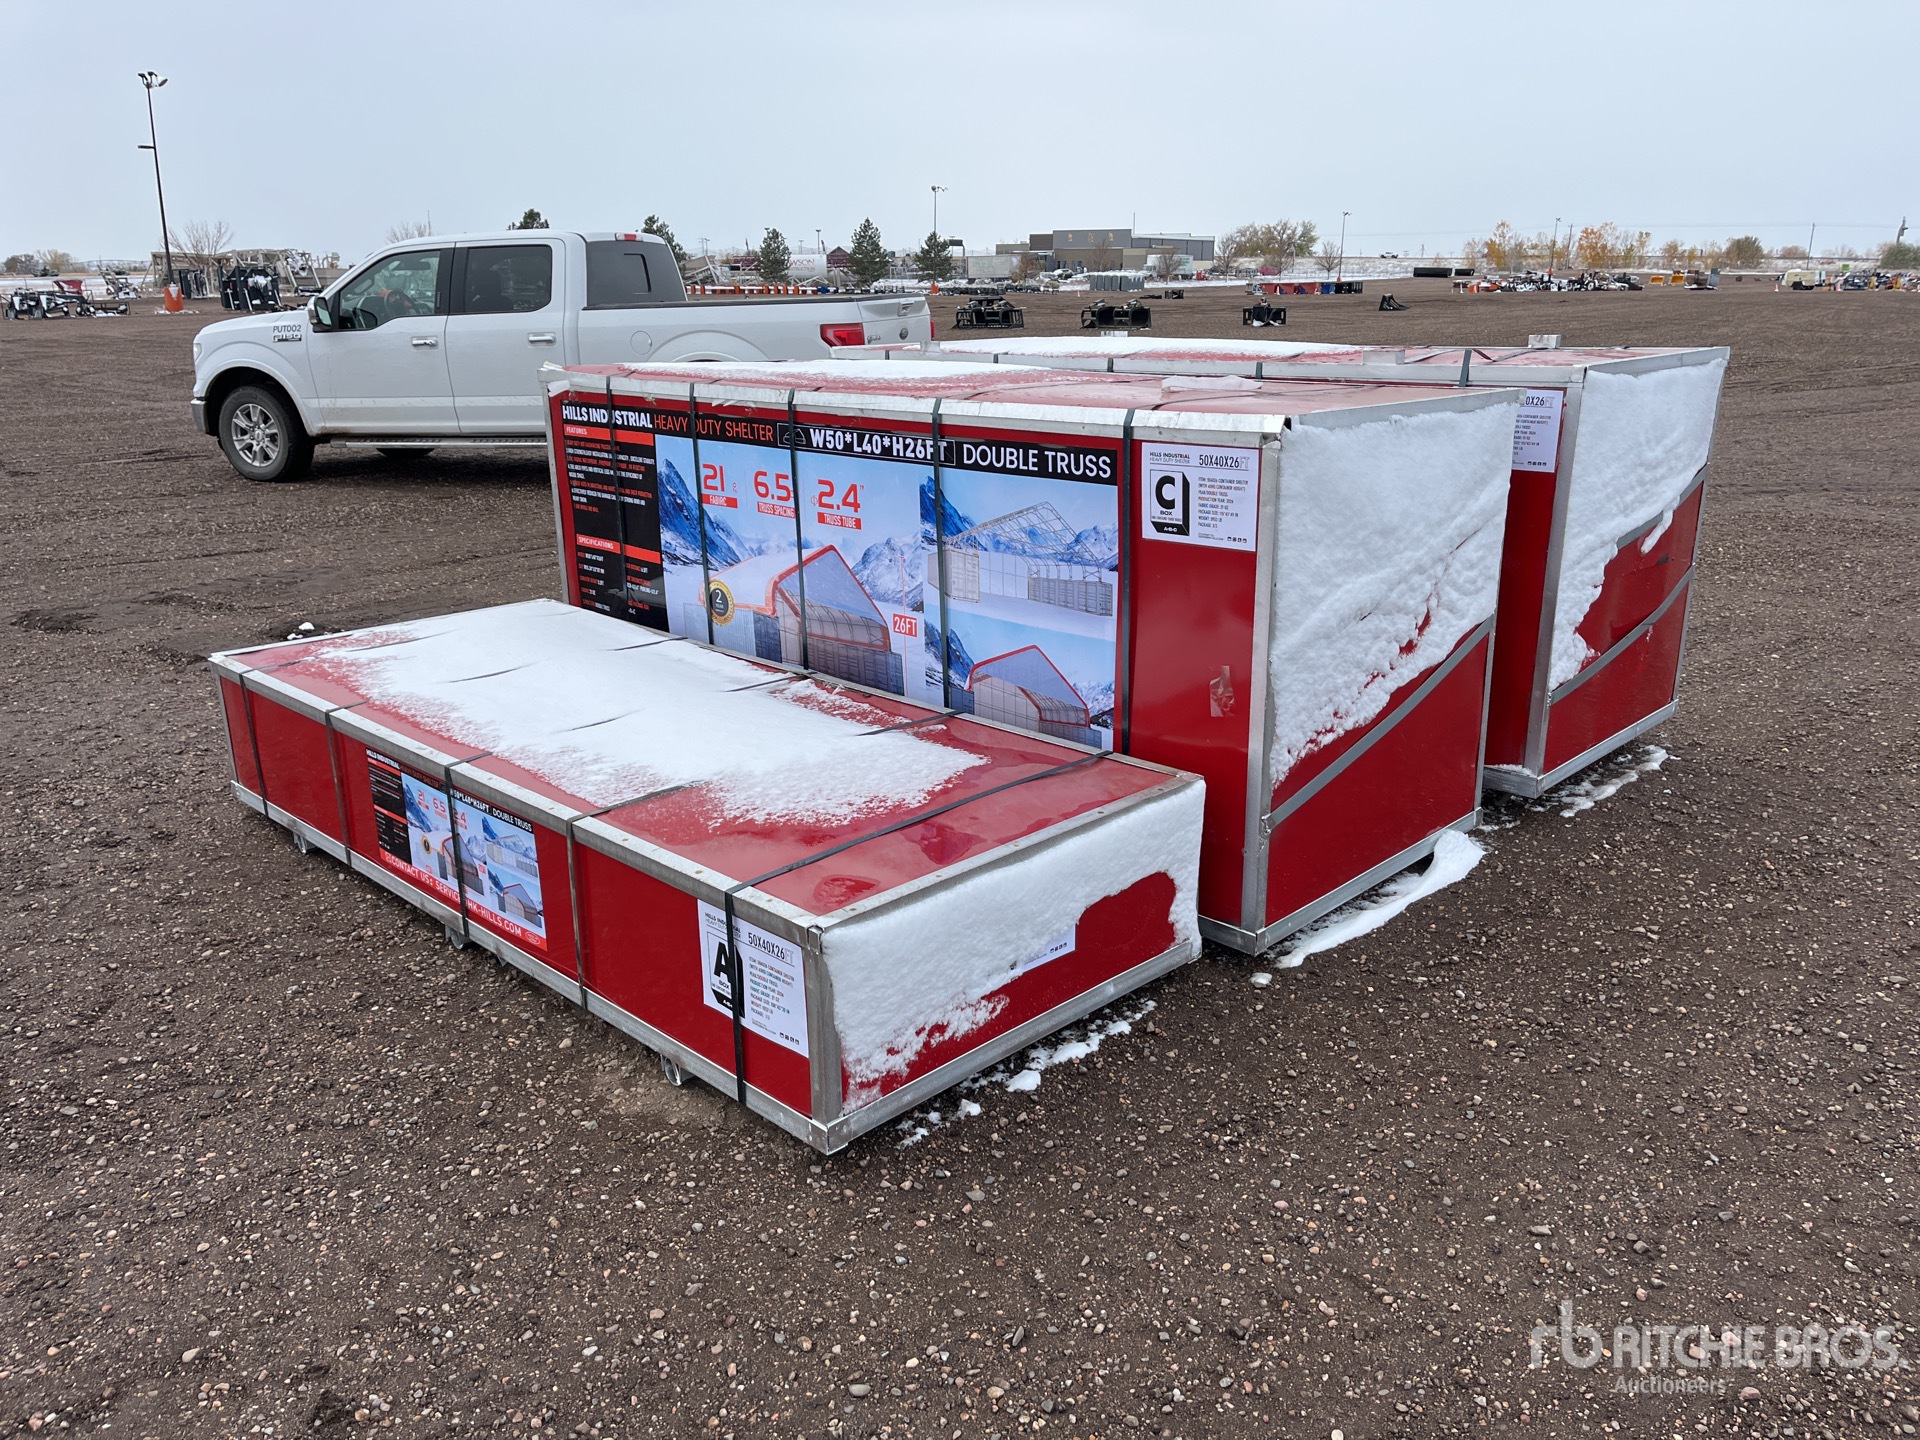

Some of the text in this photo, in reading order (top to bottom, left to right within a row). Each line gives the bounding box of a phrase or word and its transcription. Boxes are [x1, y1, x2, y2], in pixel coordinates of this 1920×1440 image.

[273, 324, 301, 332] PUT002
[562, 405, 588, 421] HILLS
[654, 414, 688, 432] HEAVY
[725, 421, 773, 441] SHELTER
[963, 444, 1111, 478] DOUBLE TRUSS
[1199, 454, 1250, 468] 50X40X26FT
[703, 463, 725, 491] 21
[754, 470, 791, 502] 6.5
[1155, 475, 1175, 510] C
[759, 503, 795, 518] TRUSS SPACING
[824, 513, 856, 528] TRUSS TUBE
[579, 536, 614, 549] SPECIFICATIONS
[716, 590, 722, 603] 2
[894, 616, 916, 635] 26FT
[492, 808, 532, 832] DOUBLE TRUSS
[392, 857, 418, 879] CONTACT
[420, 872, 433, 886] US:
[748, 932, 794, 964] 50X40X26FT
[714, 941, 732, 983] A
[719, 980, 729, 989] BOX
